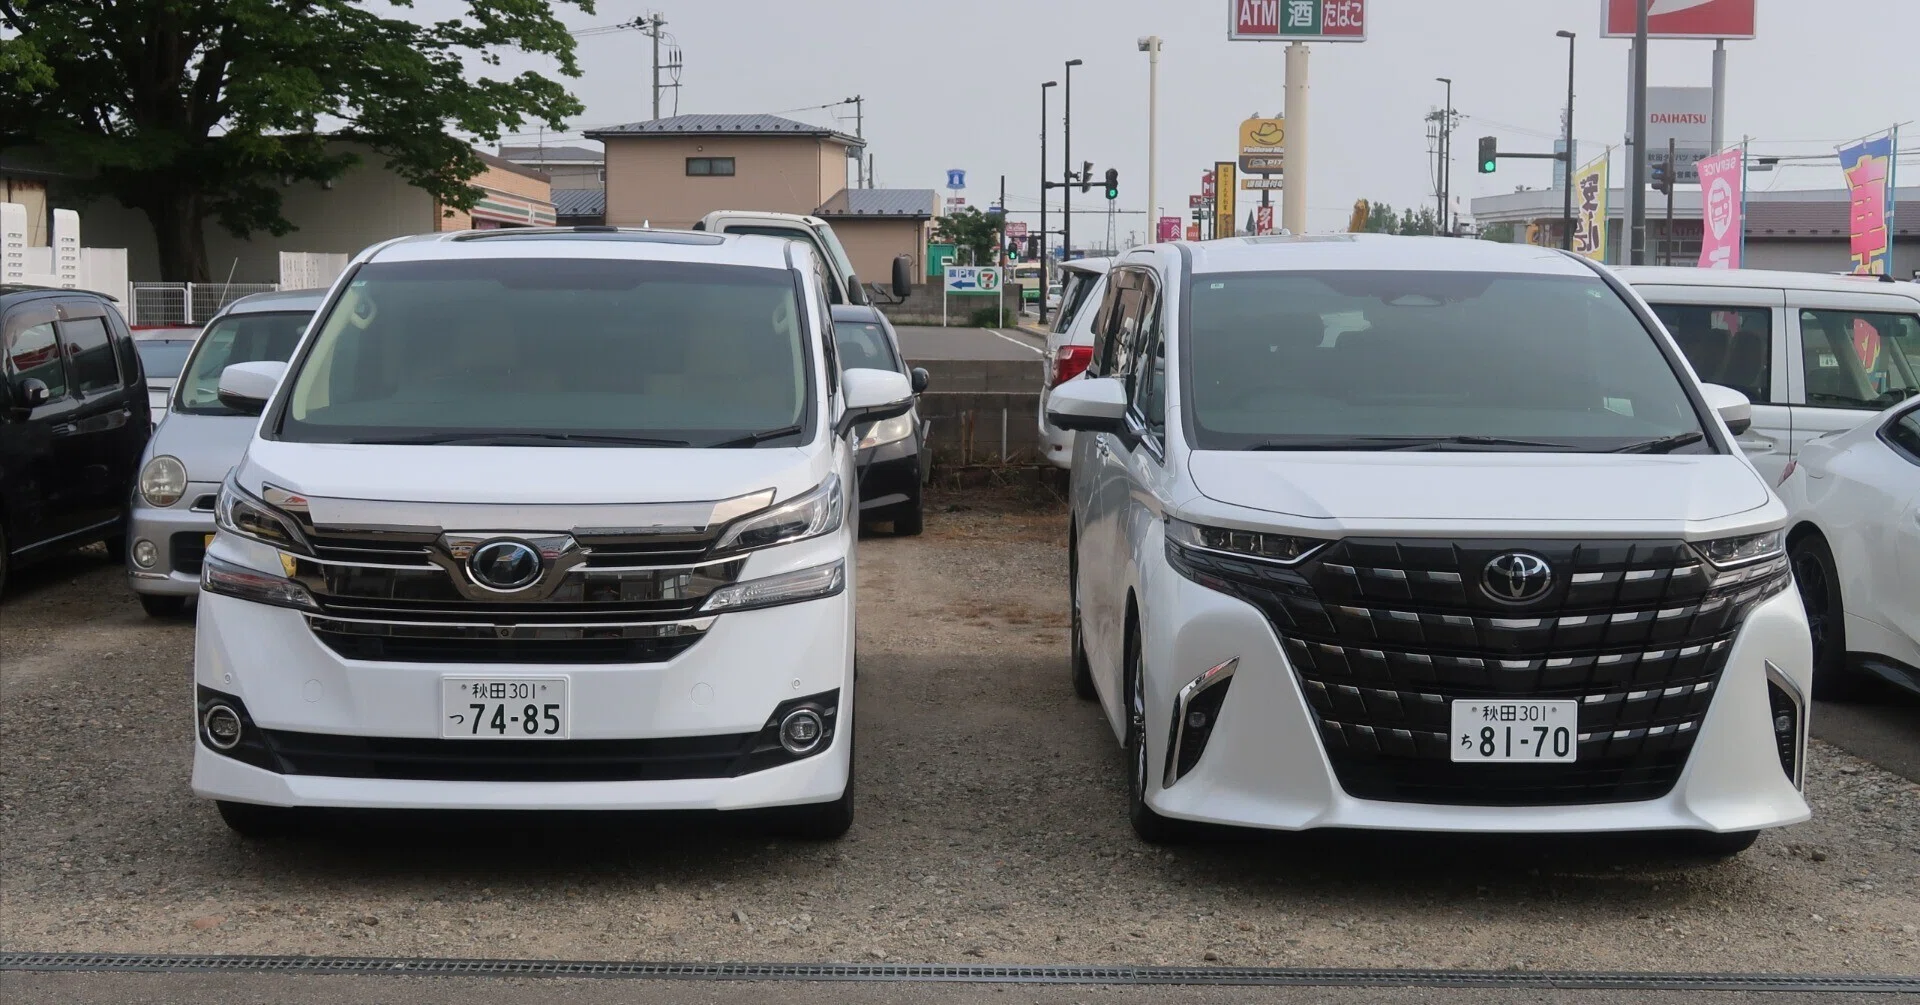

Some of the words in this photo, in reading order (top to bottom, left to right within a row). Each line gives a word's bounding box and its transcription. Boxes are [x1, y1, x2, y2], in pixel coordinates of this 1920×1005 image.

[1240, 0, 1276, 26] ATM
[1287, 0, 1313, 27] 酒
[1324, 1, 1362, 27] たばこ
[1650, 113, 1707, 124] DAIHATSU
[1648, 153, 1688, 162] 秋田ダハツ
[469, 703, 560, 735] 74-85
[1479, 726, 1570, 758] 81-70
